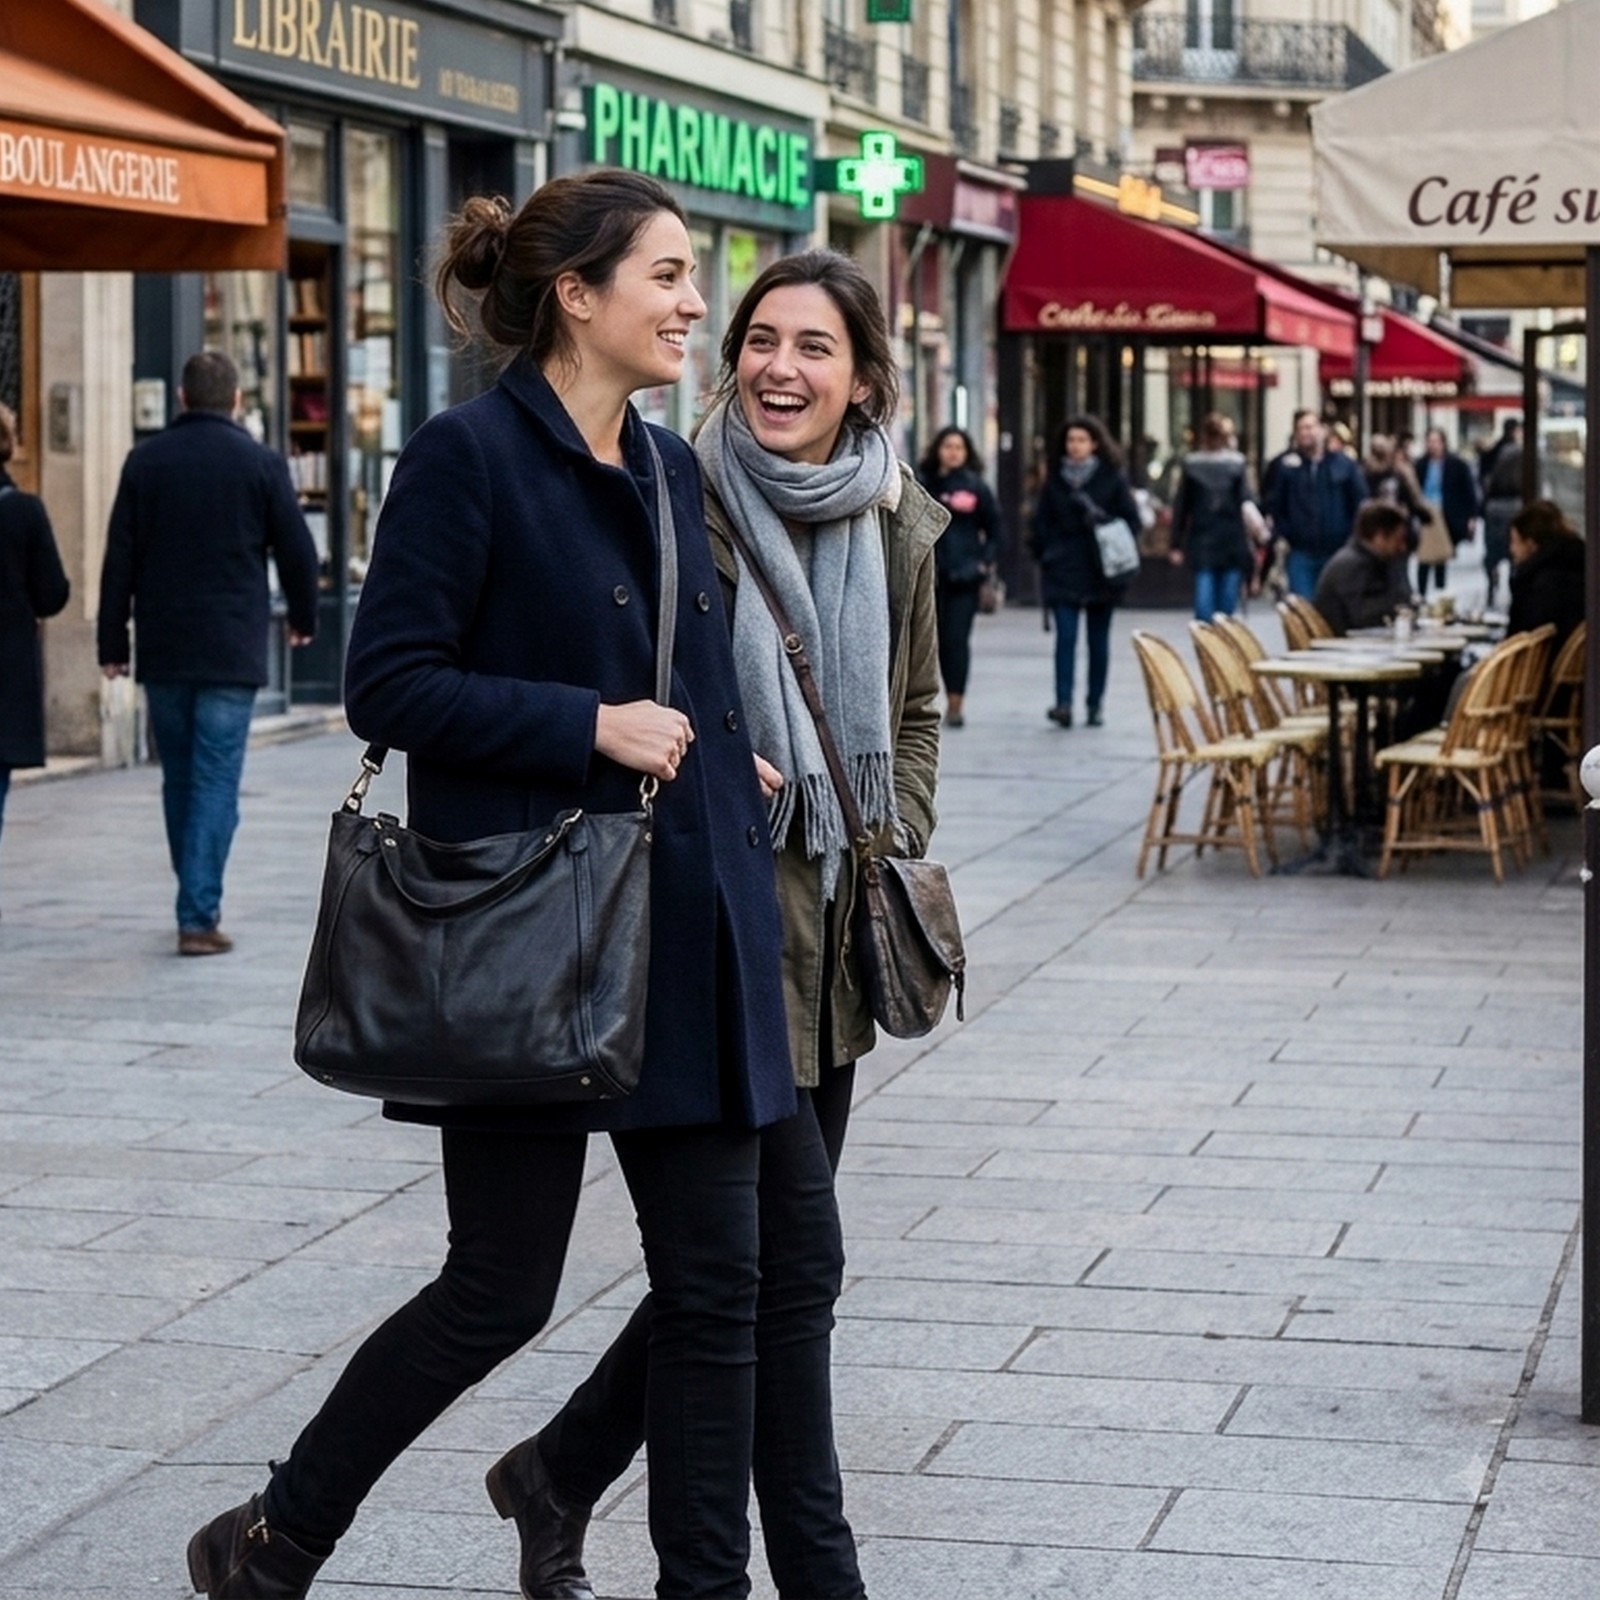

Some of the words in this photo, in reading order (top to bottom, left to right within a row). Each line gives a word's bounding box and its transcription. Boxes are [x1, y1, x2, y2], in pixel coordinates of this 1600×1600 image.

[233, 0, 421, 90] LIBRAIRIE
[0, 132, 181, 205] BOULANGERIE
[595, 82, 810, 209] PHARMACIE
[1408, 173, 1540, 235] Café
